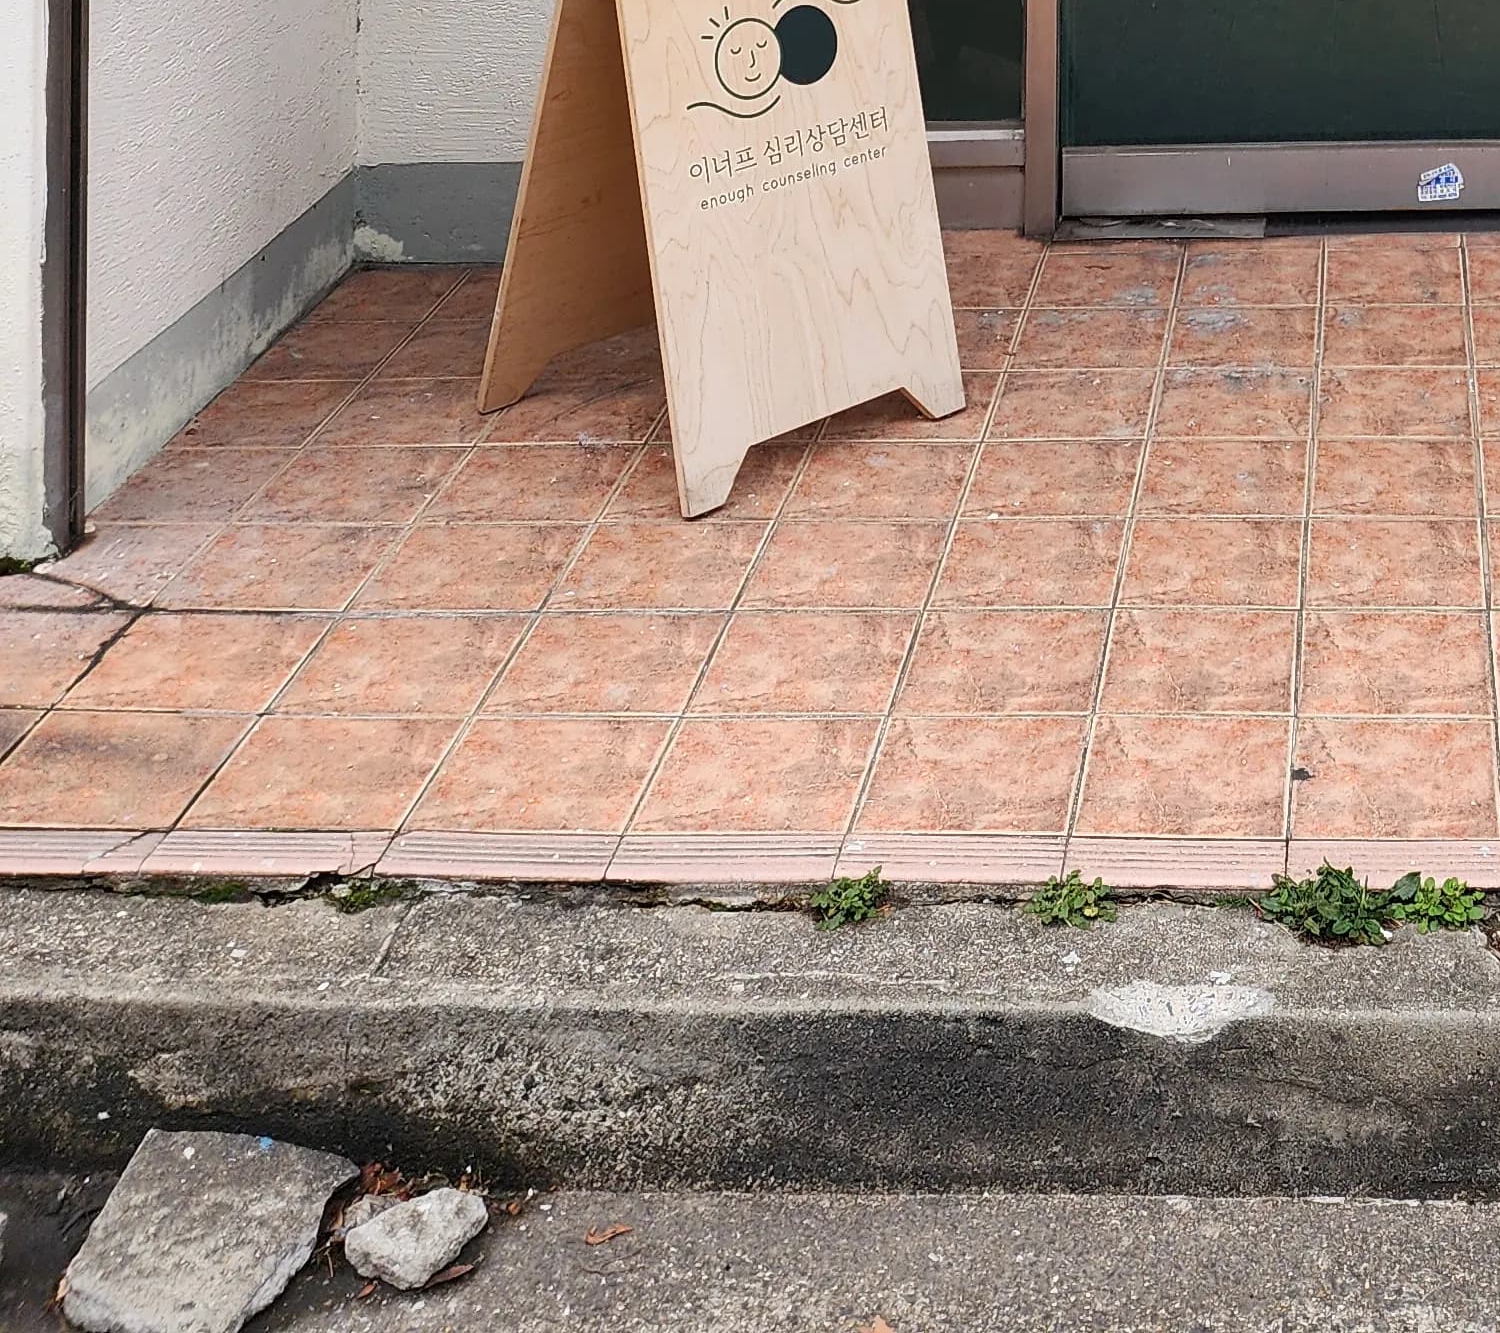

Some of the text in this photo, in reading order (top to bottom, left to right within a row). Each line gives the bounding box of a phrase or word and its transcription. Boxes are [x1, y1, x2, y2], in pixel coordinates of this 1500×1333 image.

[689, 106, 889, 183] 이너프 심리상담센터
[700, 146, 887, 210] enough counseling center
